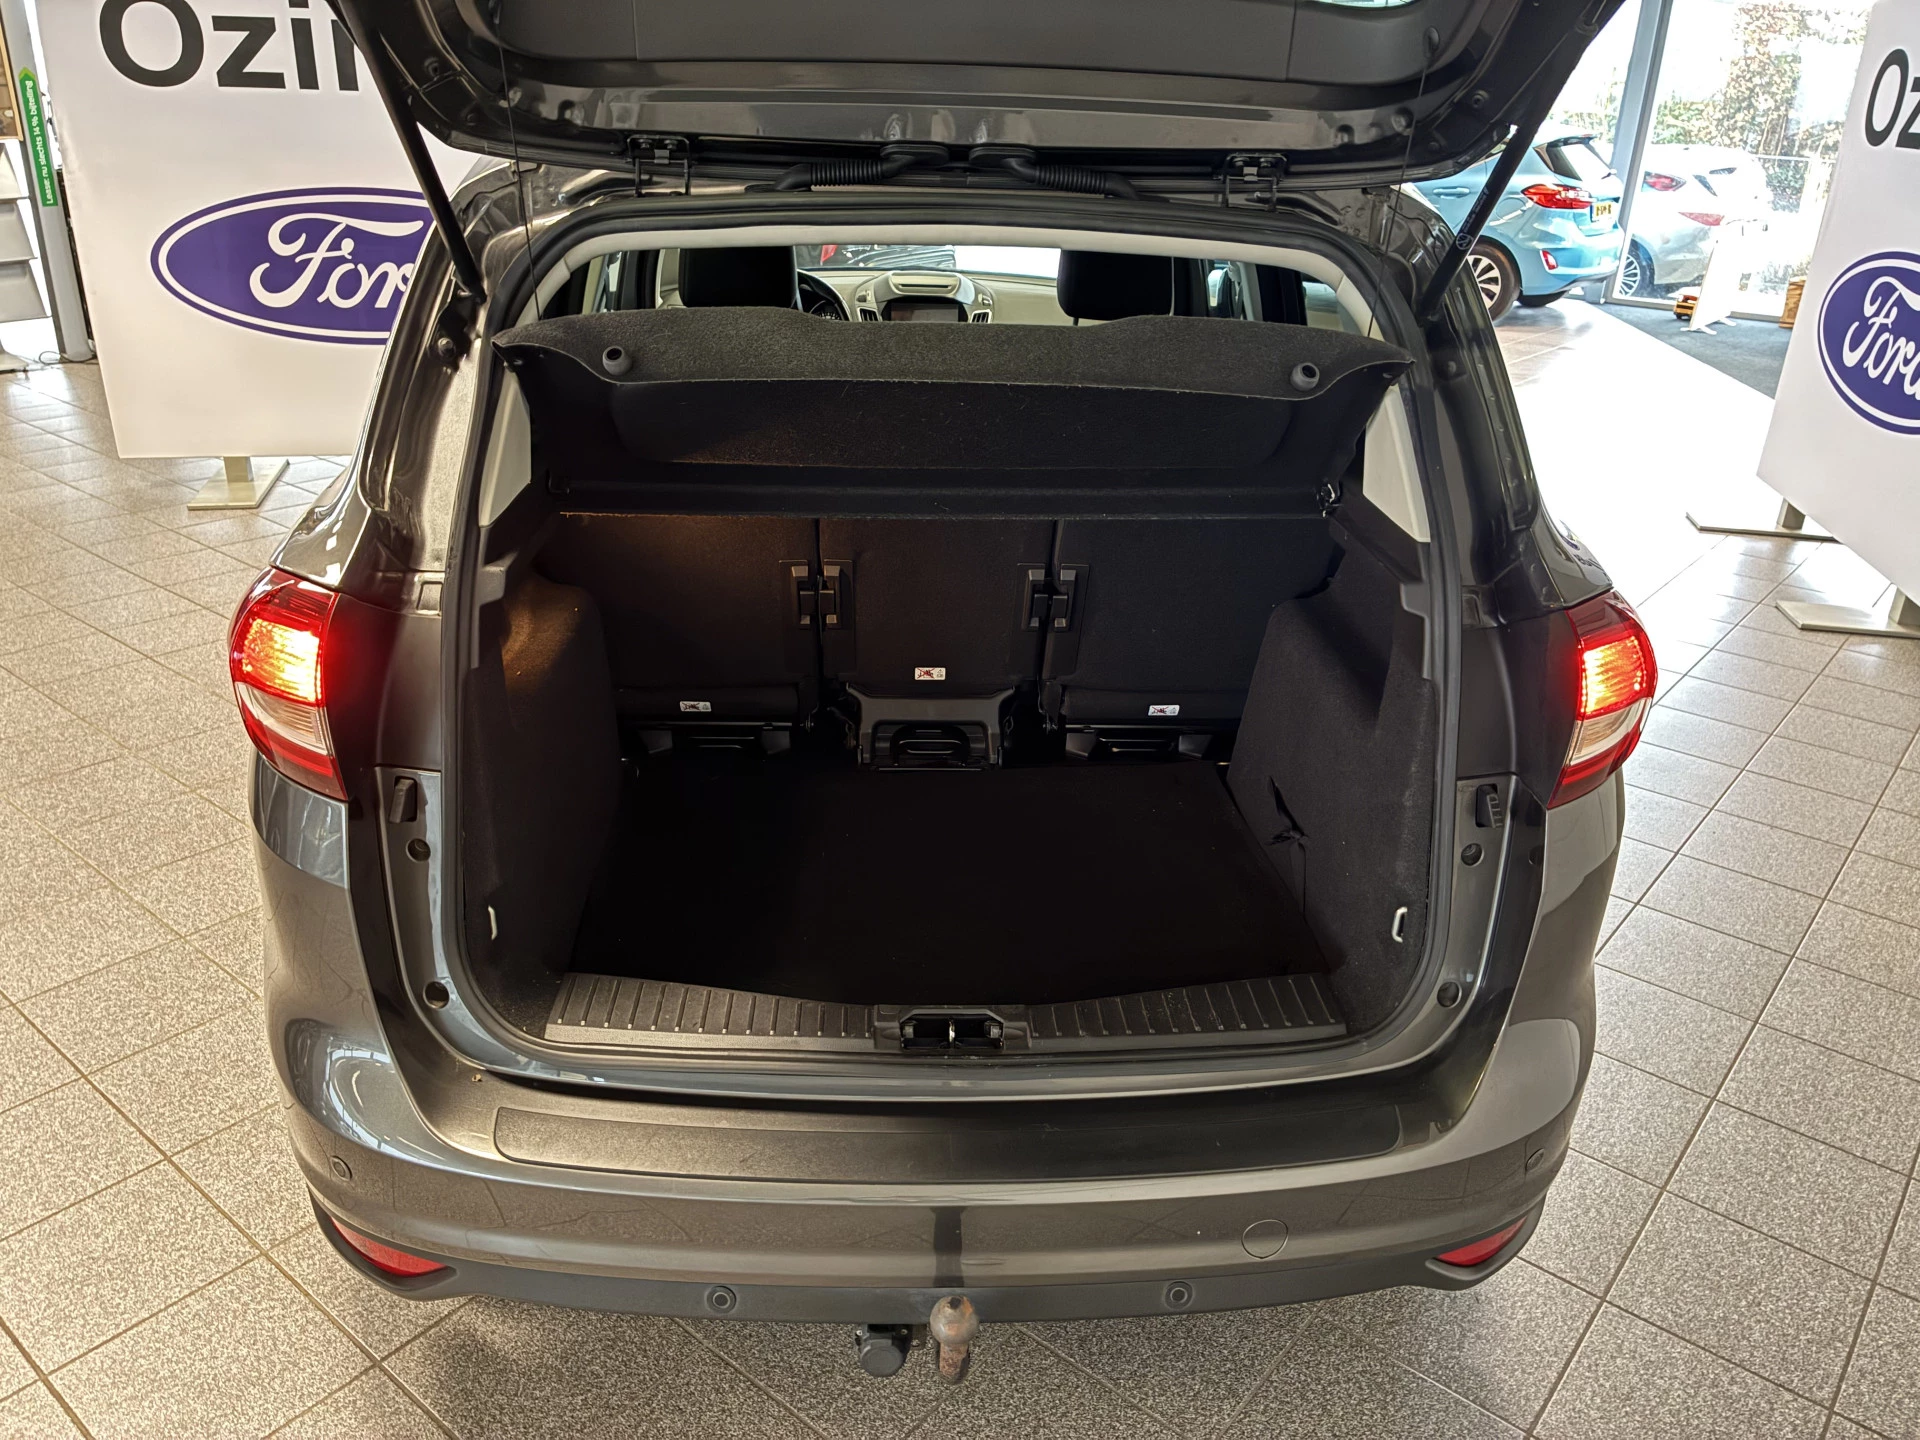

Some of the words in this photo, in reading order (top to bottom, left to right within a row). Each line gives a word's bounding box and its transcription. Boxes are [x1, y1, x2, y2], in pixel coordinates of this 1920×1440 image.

[25, 80, 38, 115] bijtelling
[36, 136, 47, 165] slechts
[41, 166, 49, 177] nu
[249, 212, 424, 309] For
